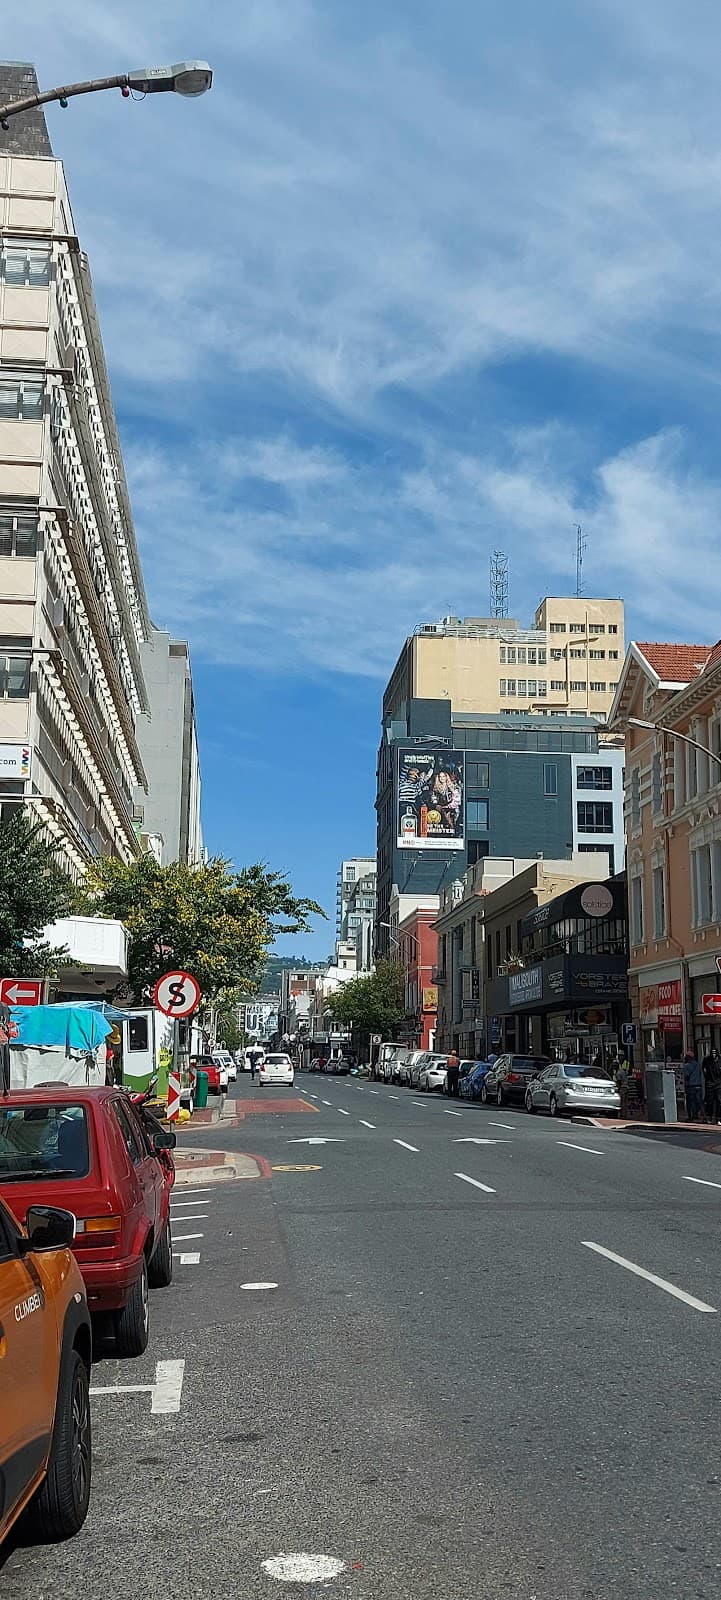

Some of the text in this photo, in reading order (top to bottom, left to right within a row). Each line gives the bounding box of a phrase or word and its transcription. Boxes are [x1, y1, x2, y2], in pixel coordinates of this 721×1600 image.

[572, 973, 627, 981] VORSTER
[168, 982, 186, 1006] S
[658, 984, 671, 999] FOOD
[626, 1025, 632, 1033] P
[15, 1292, 43, 1321] CLIMBER
